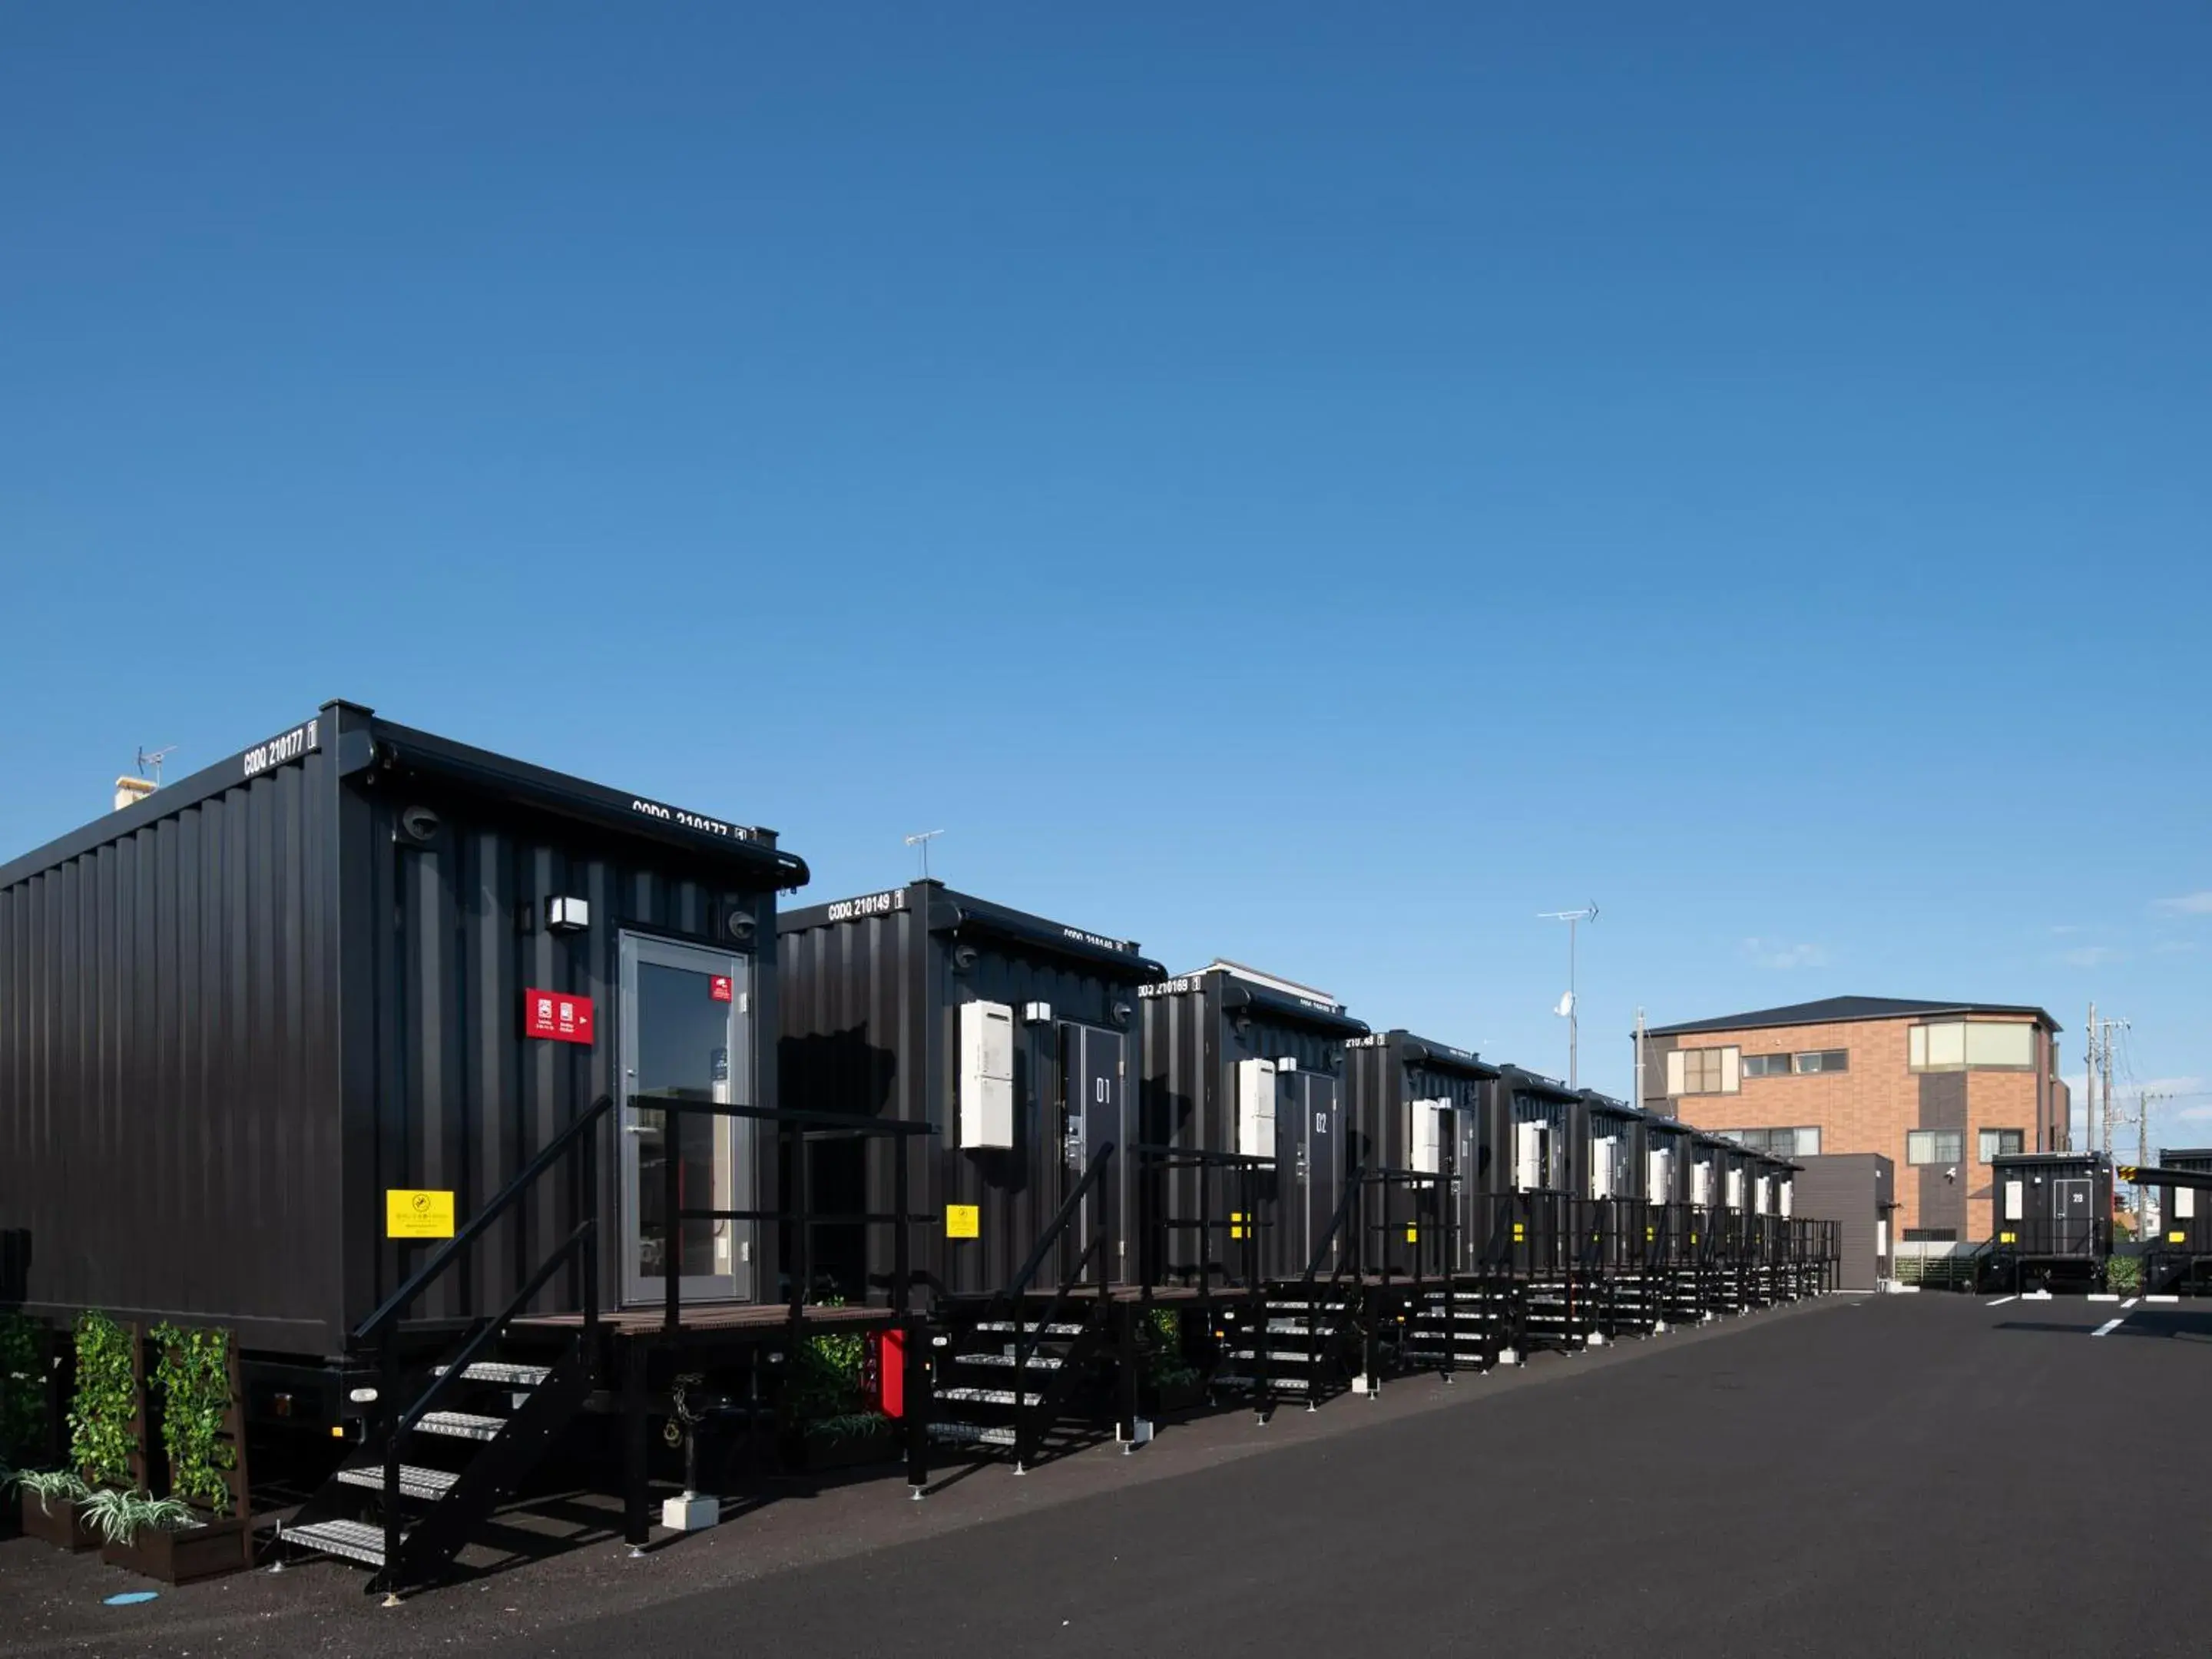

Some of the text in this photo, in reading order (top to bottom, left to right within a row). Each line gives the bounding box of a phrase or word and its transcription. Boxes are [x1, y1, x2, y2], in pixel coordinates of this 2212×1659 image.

[269, 728, 303, 765] 210177
[854, 893, 890, 915] 210149
[1096, 1077, 1110, 1104] 01
[1316, 1112, 1327, 1134] 02
